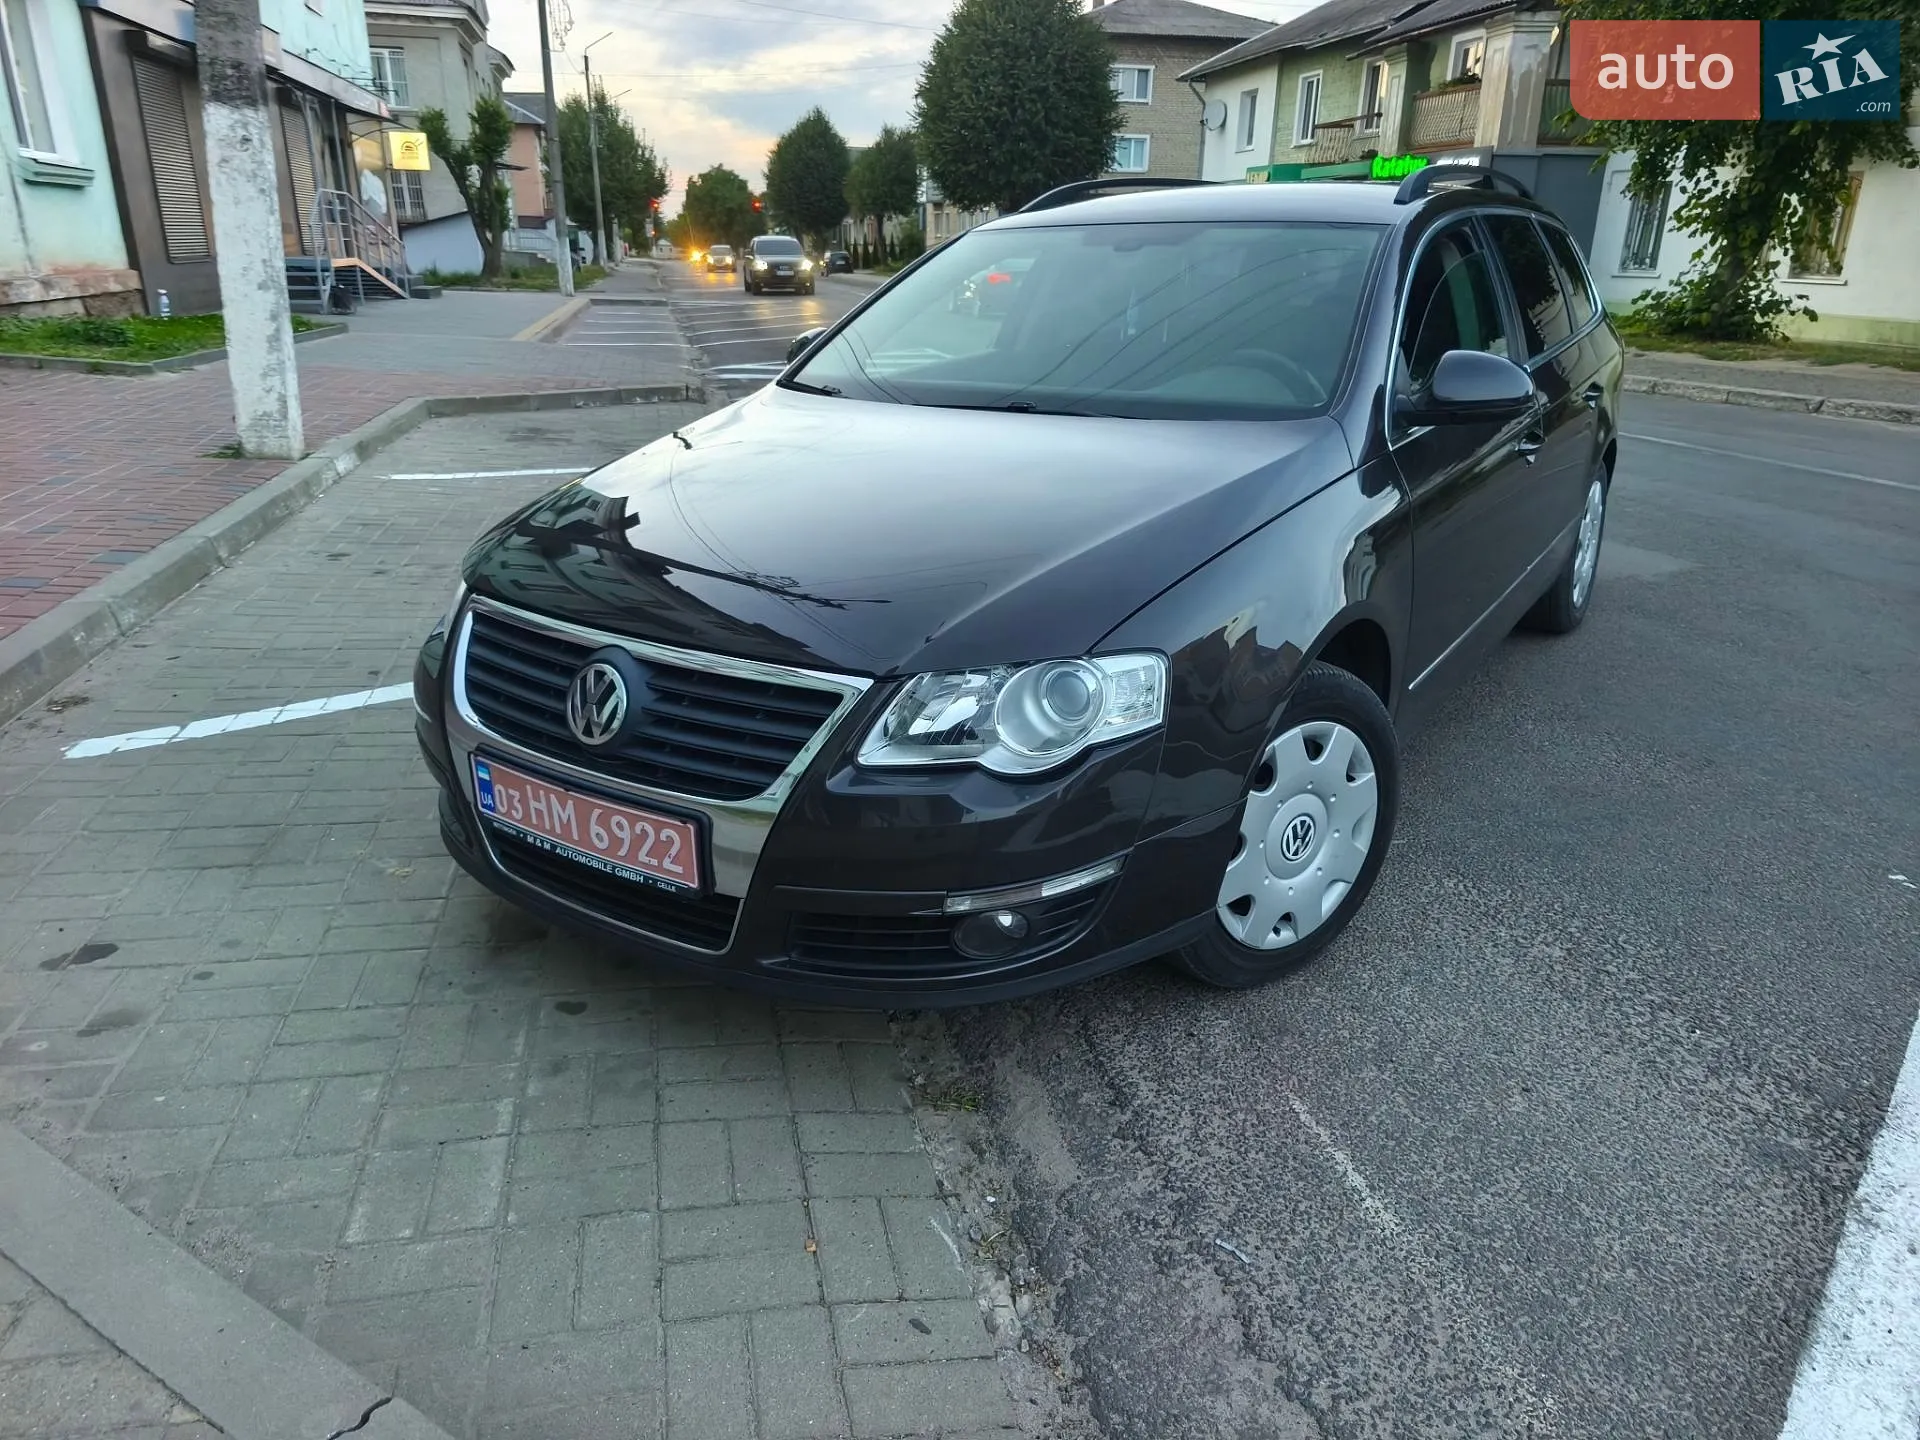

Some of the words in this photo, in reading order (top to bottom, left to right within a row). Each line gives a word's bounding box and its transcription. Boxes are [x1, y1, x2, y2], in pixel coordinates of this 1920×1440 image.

[481, 791, 494, 808] UA
[494, 783, 523, 821] 03
[526, 784, 579, 841] HM
[589, 808, 684, 874] 6922
[543, 841, 551, 850] M
[555, 846, 613, 874] AUTOMOBILE
[615, 867, 644, 883] GMBH
[657, 881, 676, 892] CELLE
